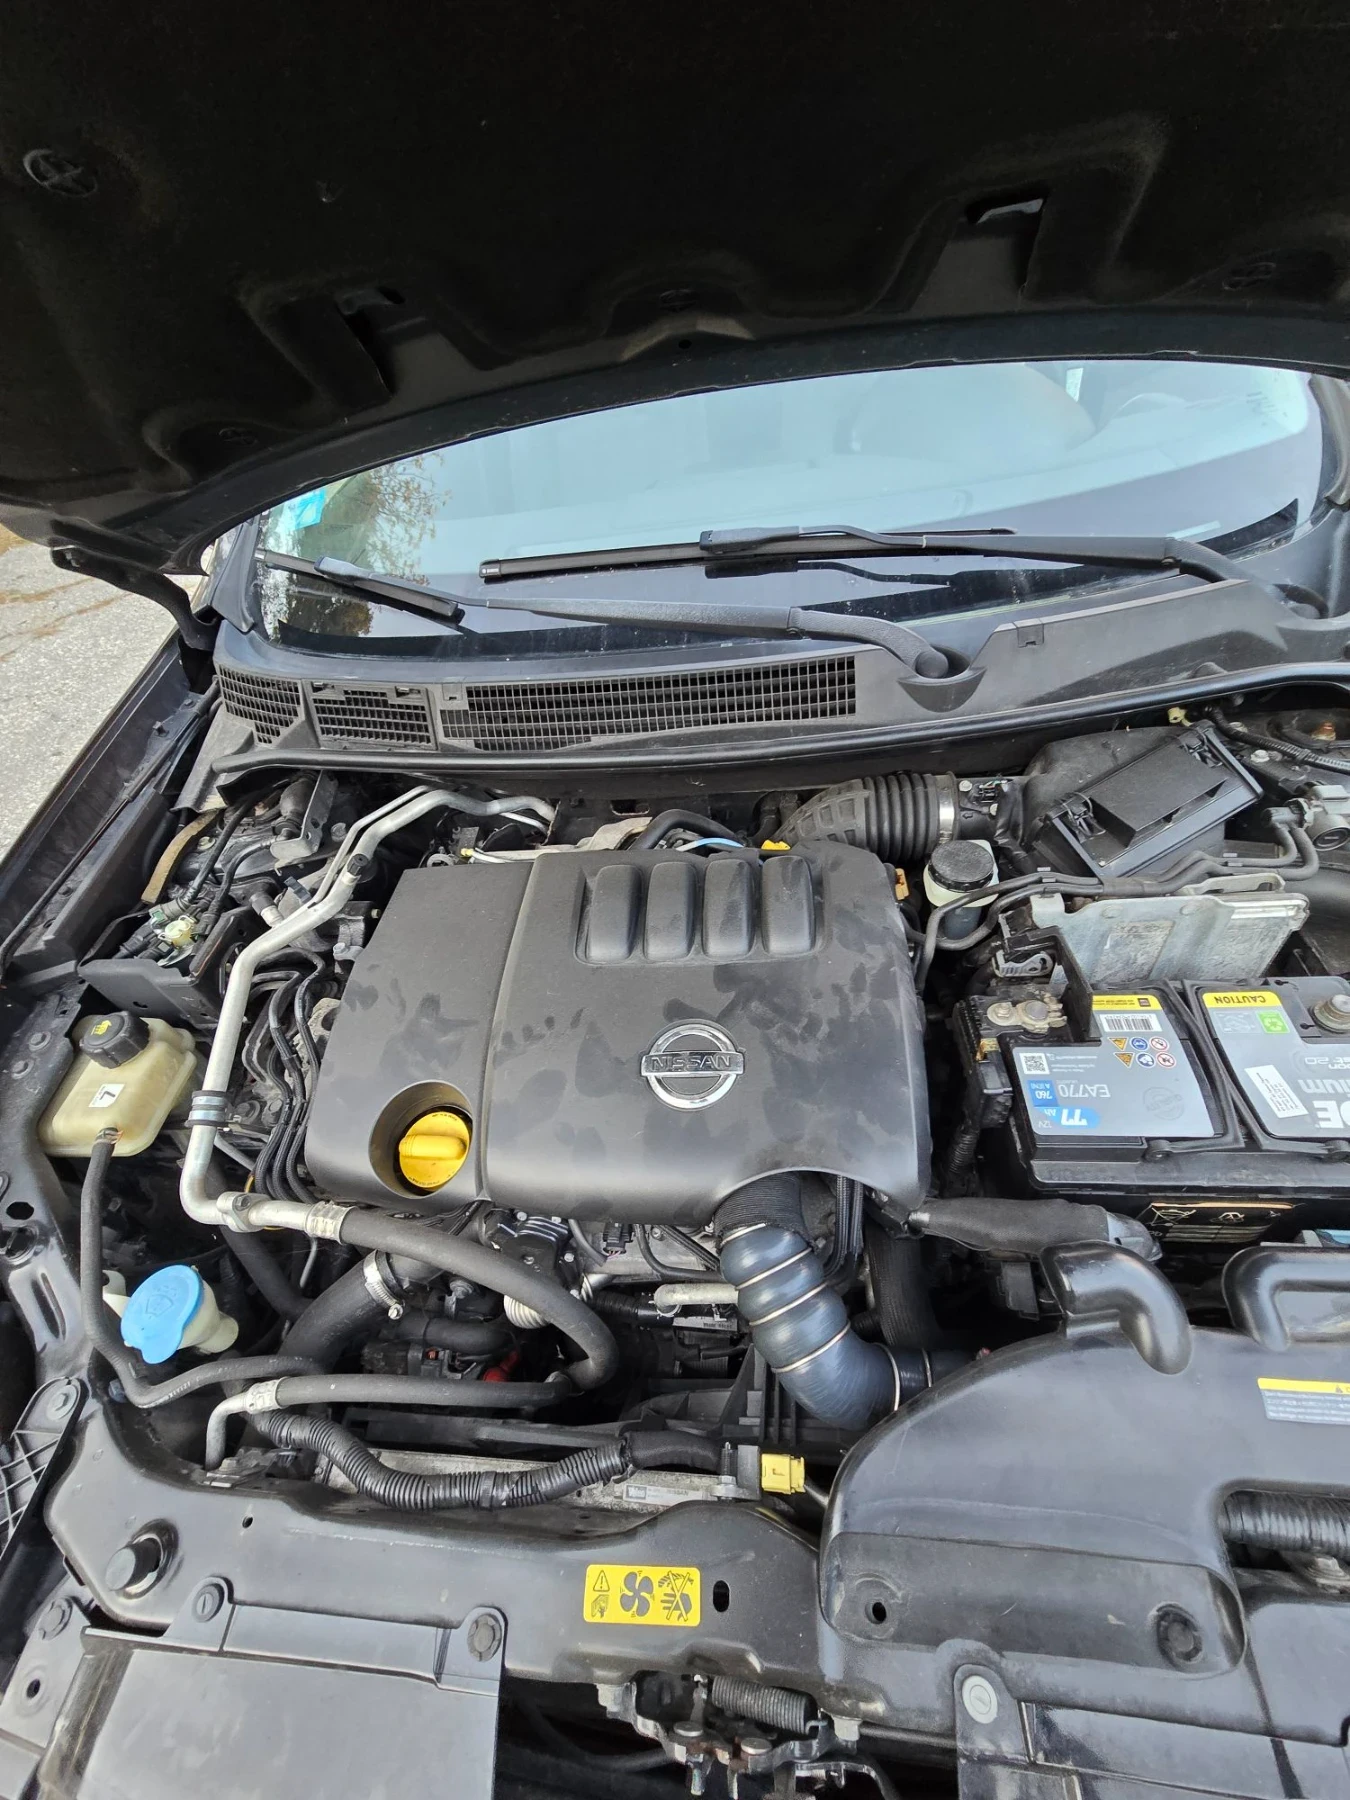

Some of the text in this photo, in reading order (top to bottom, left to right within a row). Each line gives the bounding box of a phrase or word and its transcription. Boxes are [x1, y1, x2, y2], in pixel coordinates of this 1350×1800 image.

[1214, 995, 1267, 1004] CAUTION
[651, 1055, 731, 1072] NISSAN
[1058, 1084, 1111, 1098] EA770
[1061, 1108, 1088, 1126] 77
